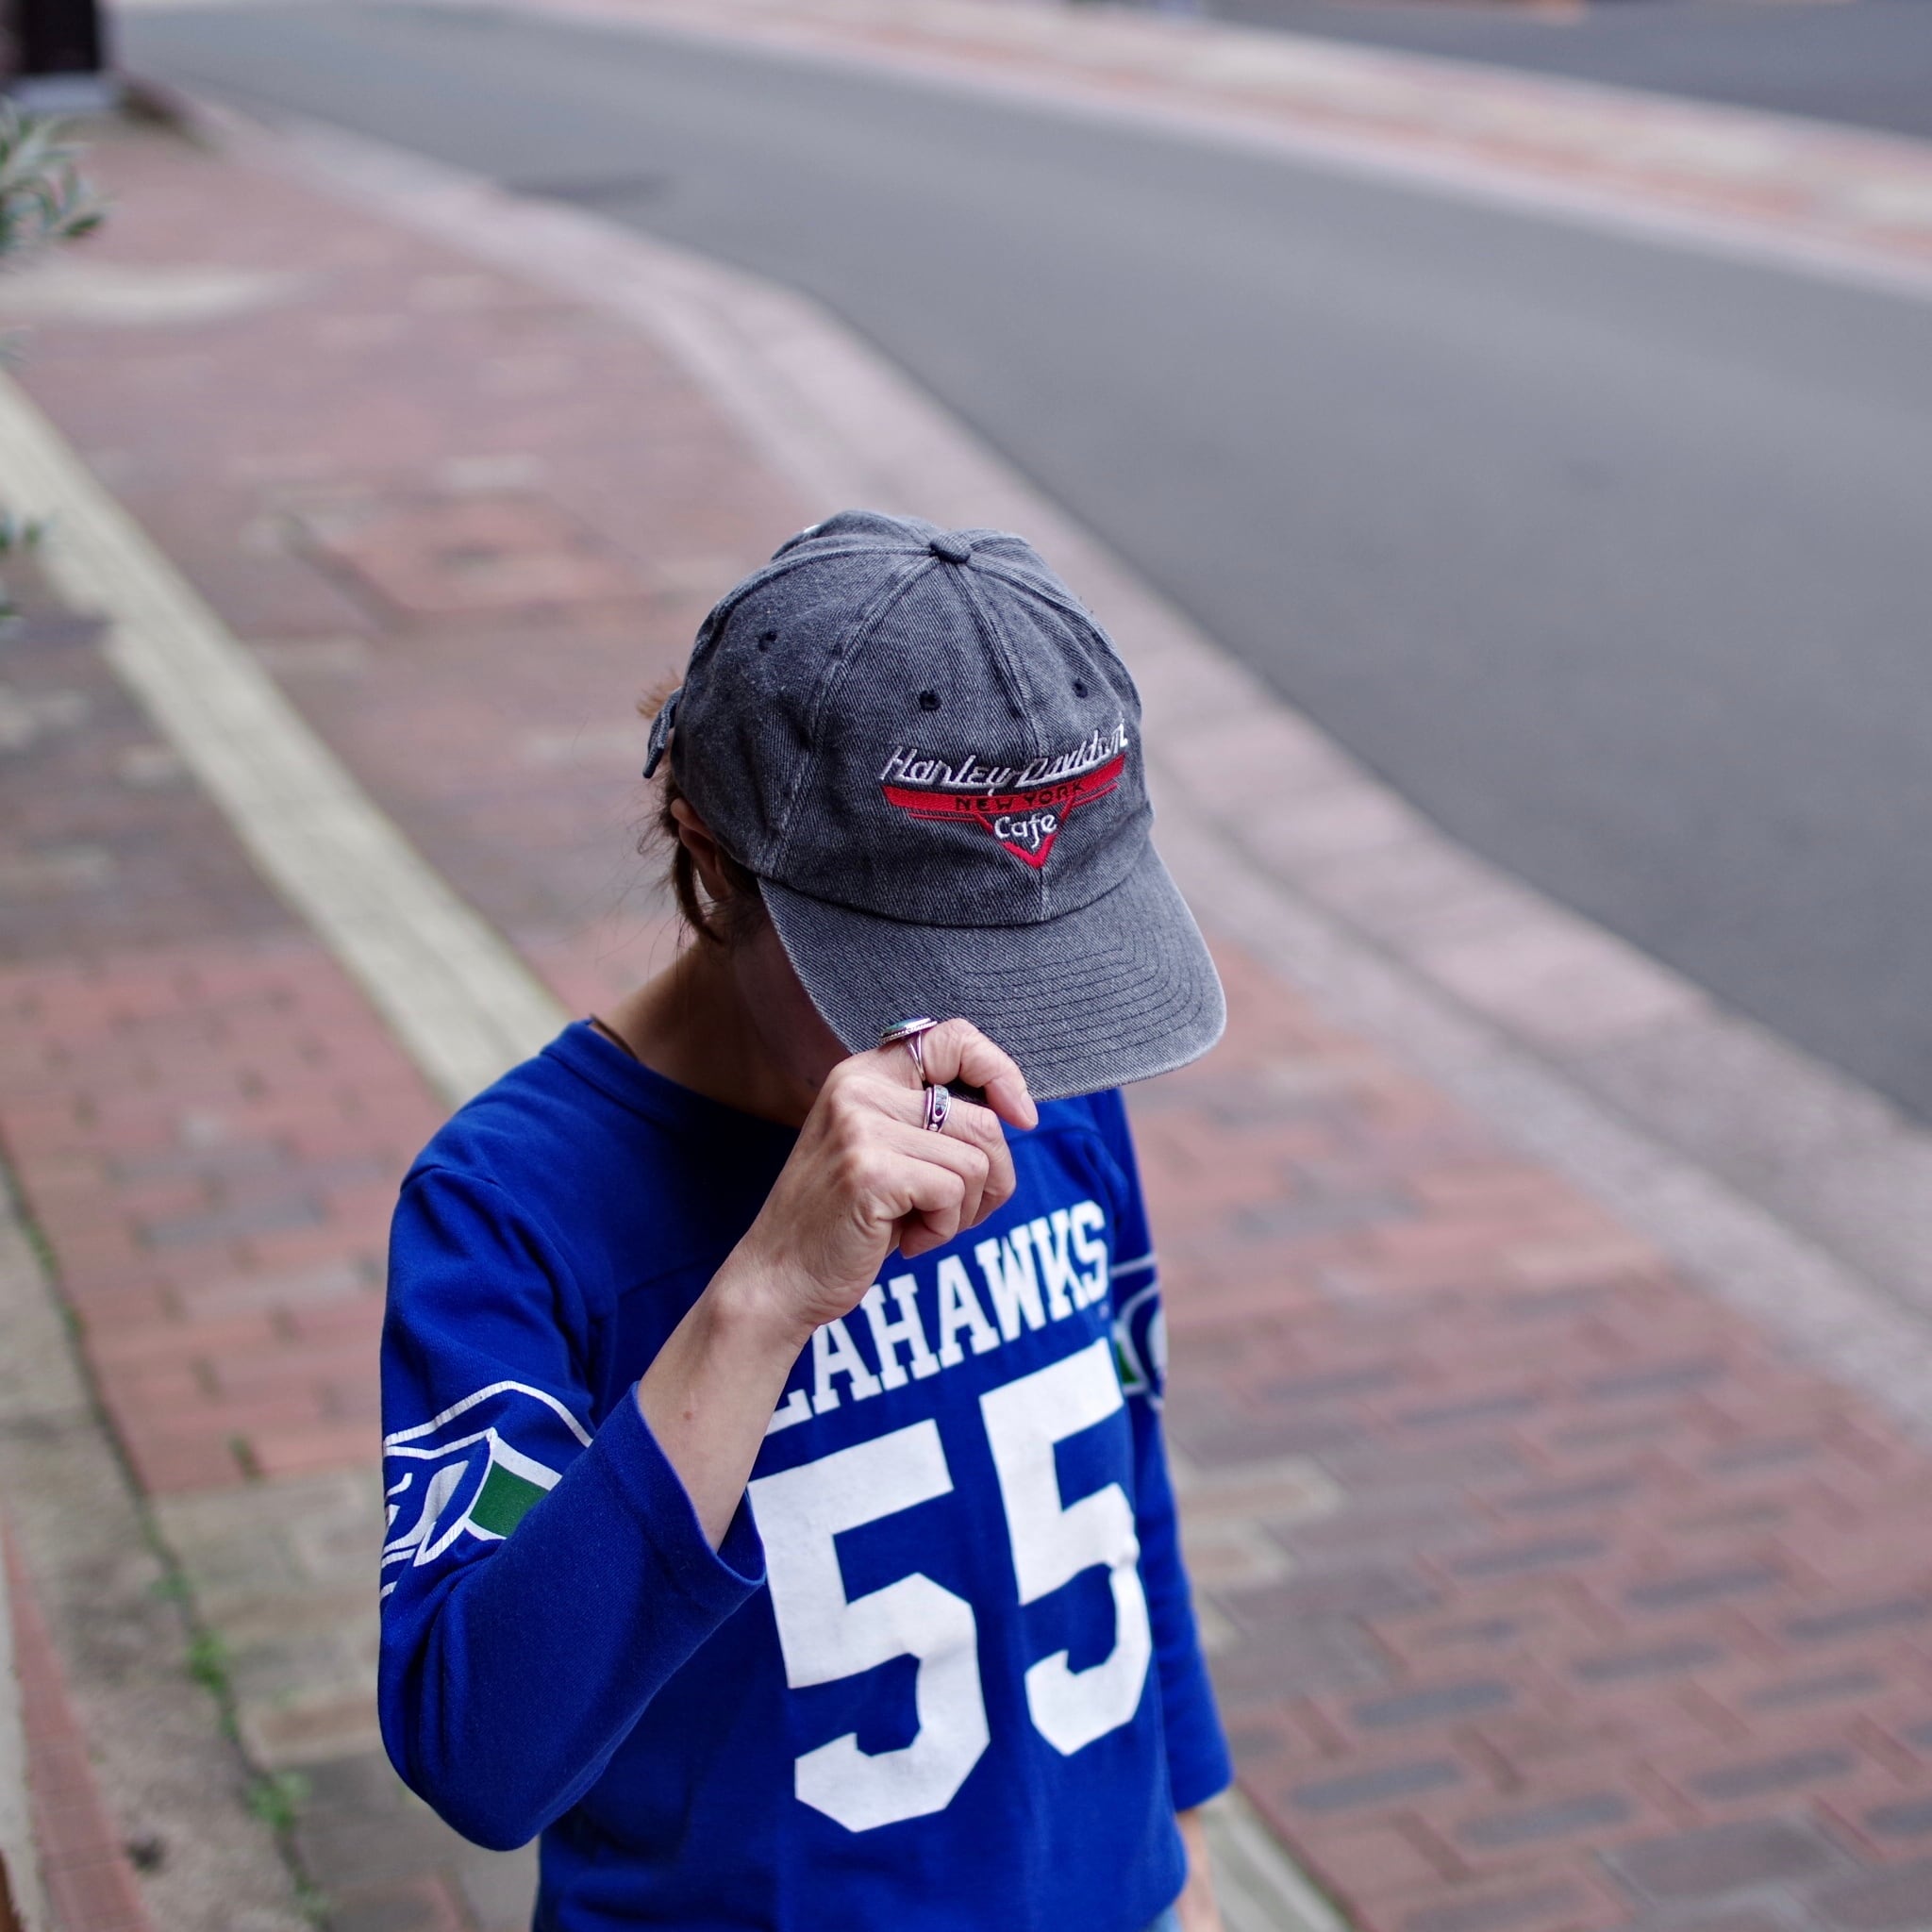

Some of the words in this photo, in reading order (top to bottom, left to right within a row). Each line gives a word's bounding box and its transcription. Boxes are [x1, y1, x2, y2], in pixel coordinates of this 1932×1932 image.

[955, 796, 1014, 812] NEW
[1024, 778, 1085, 807] YORK
[994, 812, 1058, 849] Cafe
[747, 1337, 1153, 1833] 55
